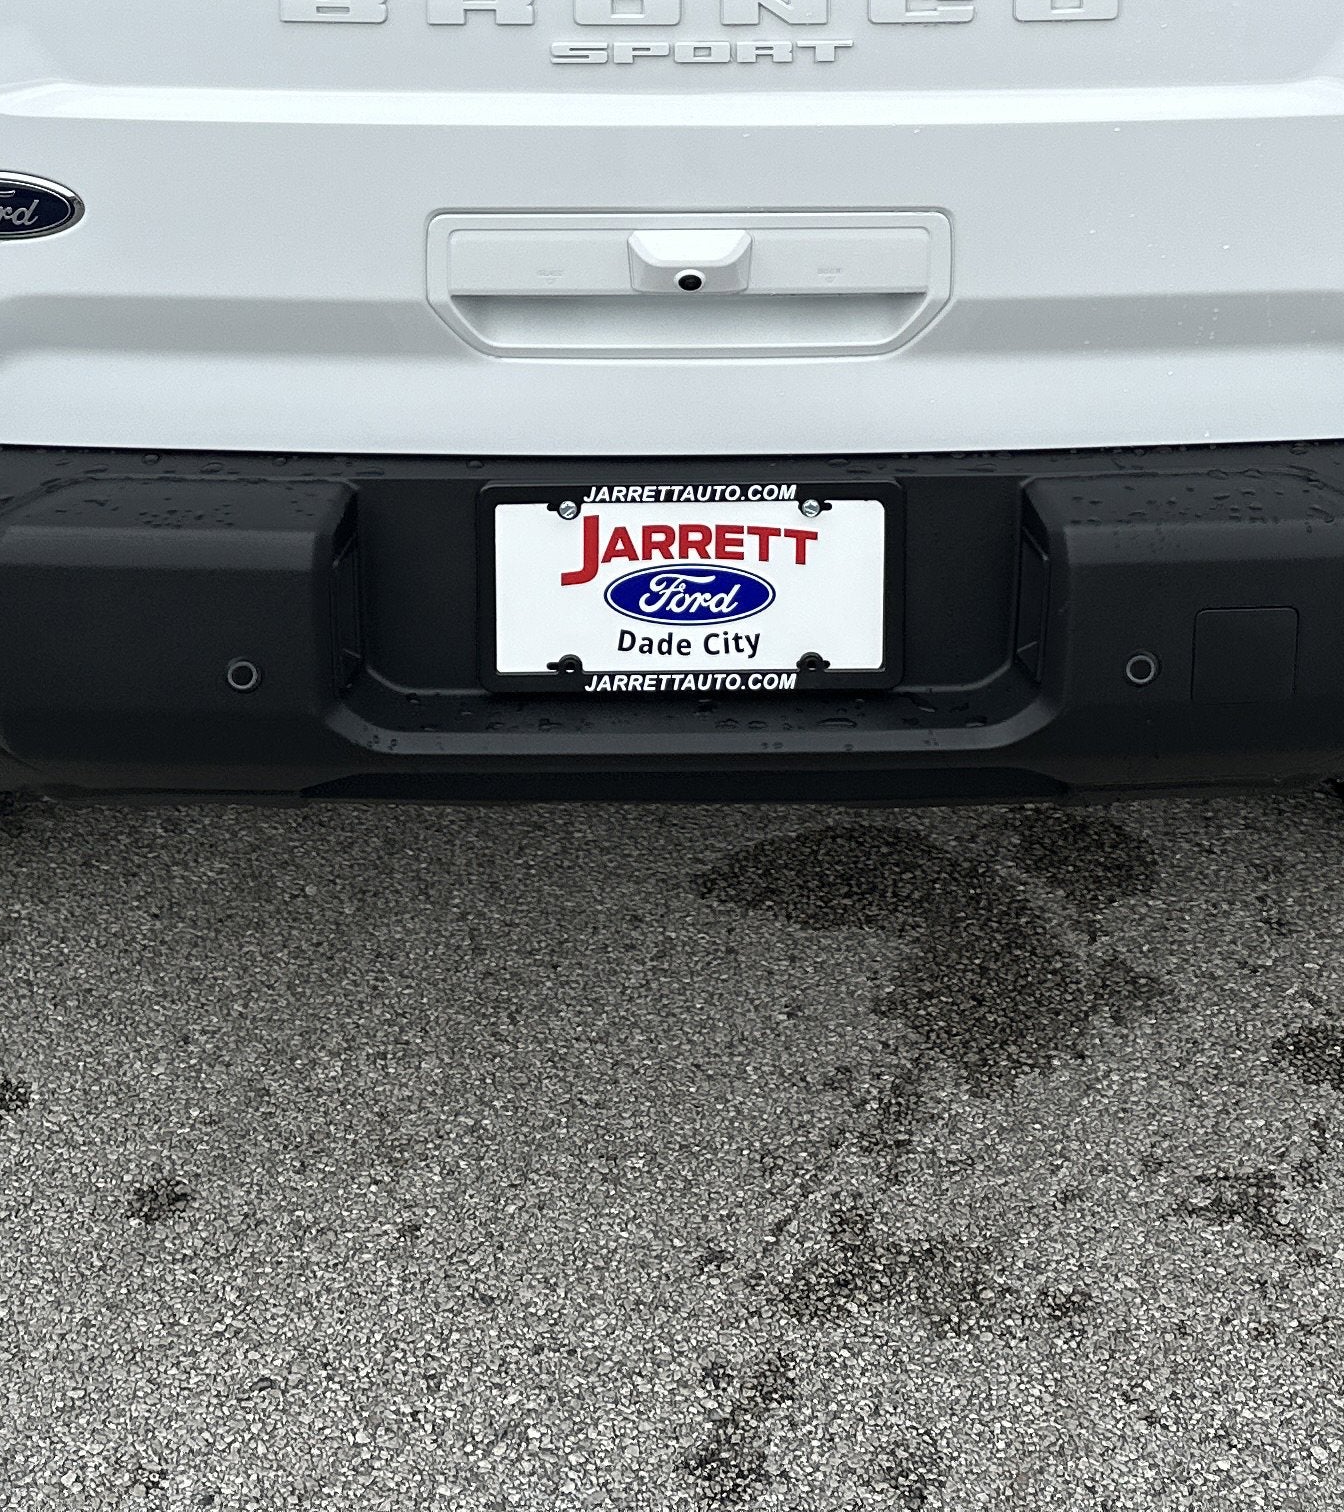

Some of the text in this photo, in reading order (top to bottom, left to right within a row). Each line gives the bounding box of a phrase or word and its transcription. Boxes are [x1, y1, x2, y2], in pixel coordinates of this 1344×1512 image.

[550, 40, 854, 65] SPORT
[583, 484, 797, 503] JARRETTAUTO.COM
[561, 515, 819, 586] JARRETT
[639, 573, 740, 614] Ford
[617, 629, 761, 659] Dade City
[584, 673, 797, 692] JARRETTAUTO.COM
